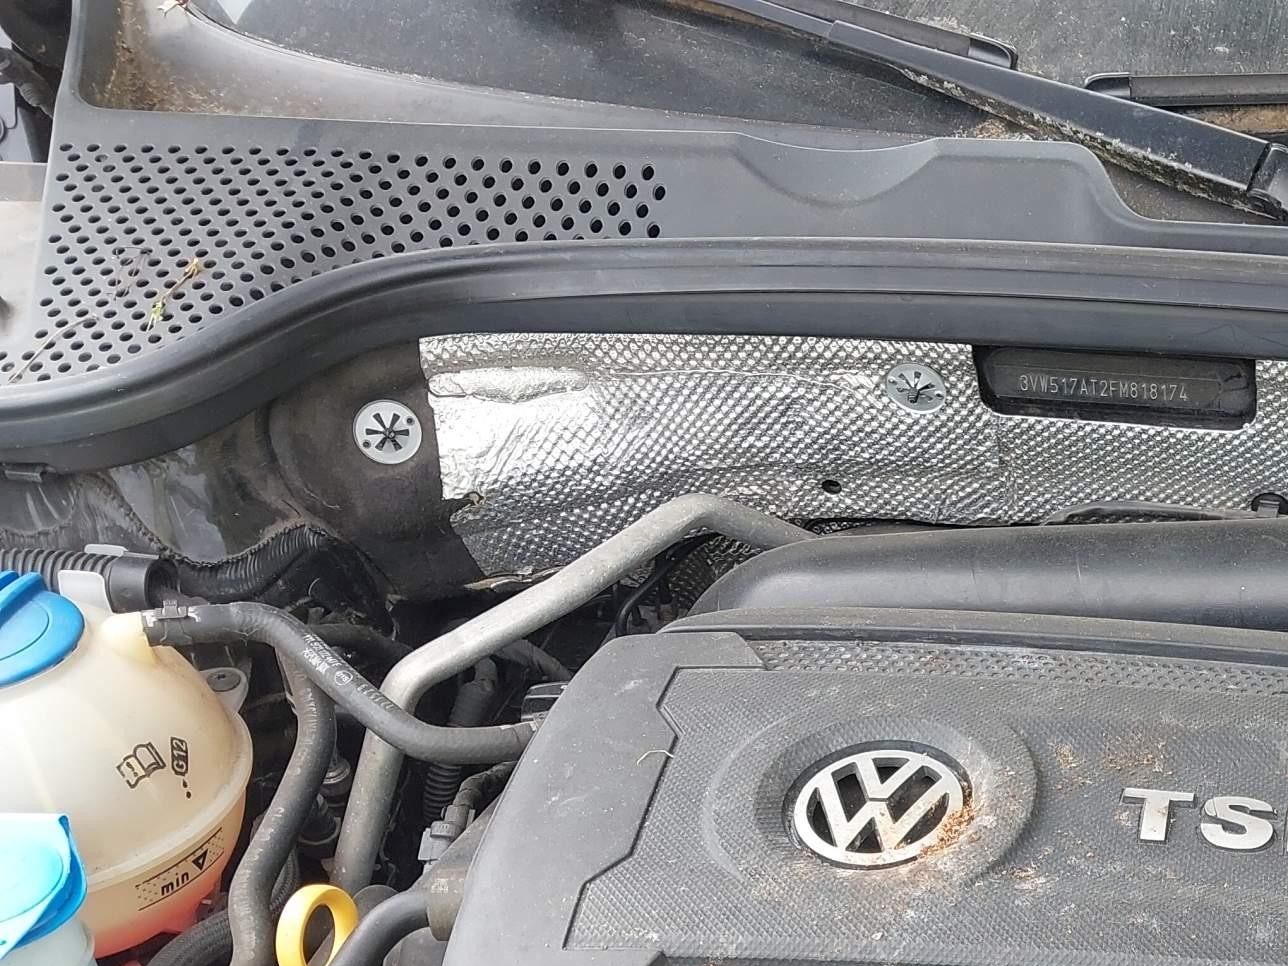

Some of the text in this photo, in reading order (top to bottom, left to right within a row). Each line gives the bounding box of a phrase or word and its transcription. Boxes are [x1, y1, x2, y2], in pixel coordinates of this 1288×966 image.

[1018, 373, 1188, 402] 3VW517AT2FM818174
[173, 740, 187, 774] G12
[161, 871, 190, 895] min
